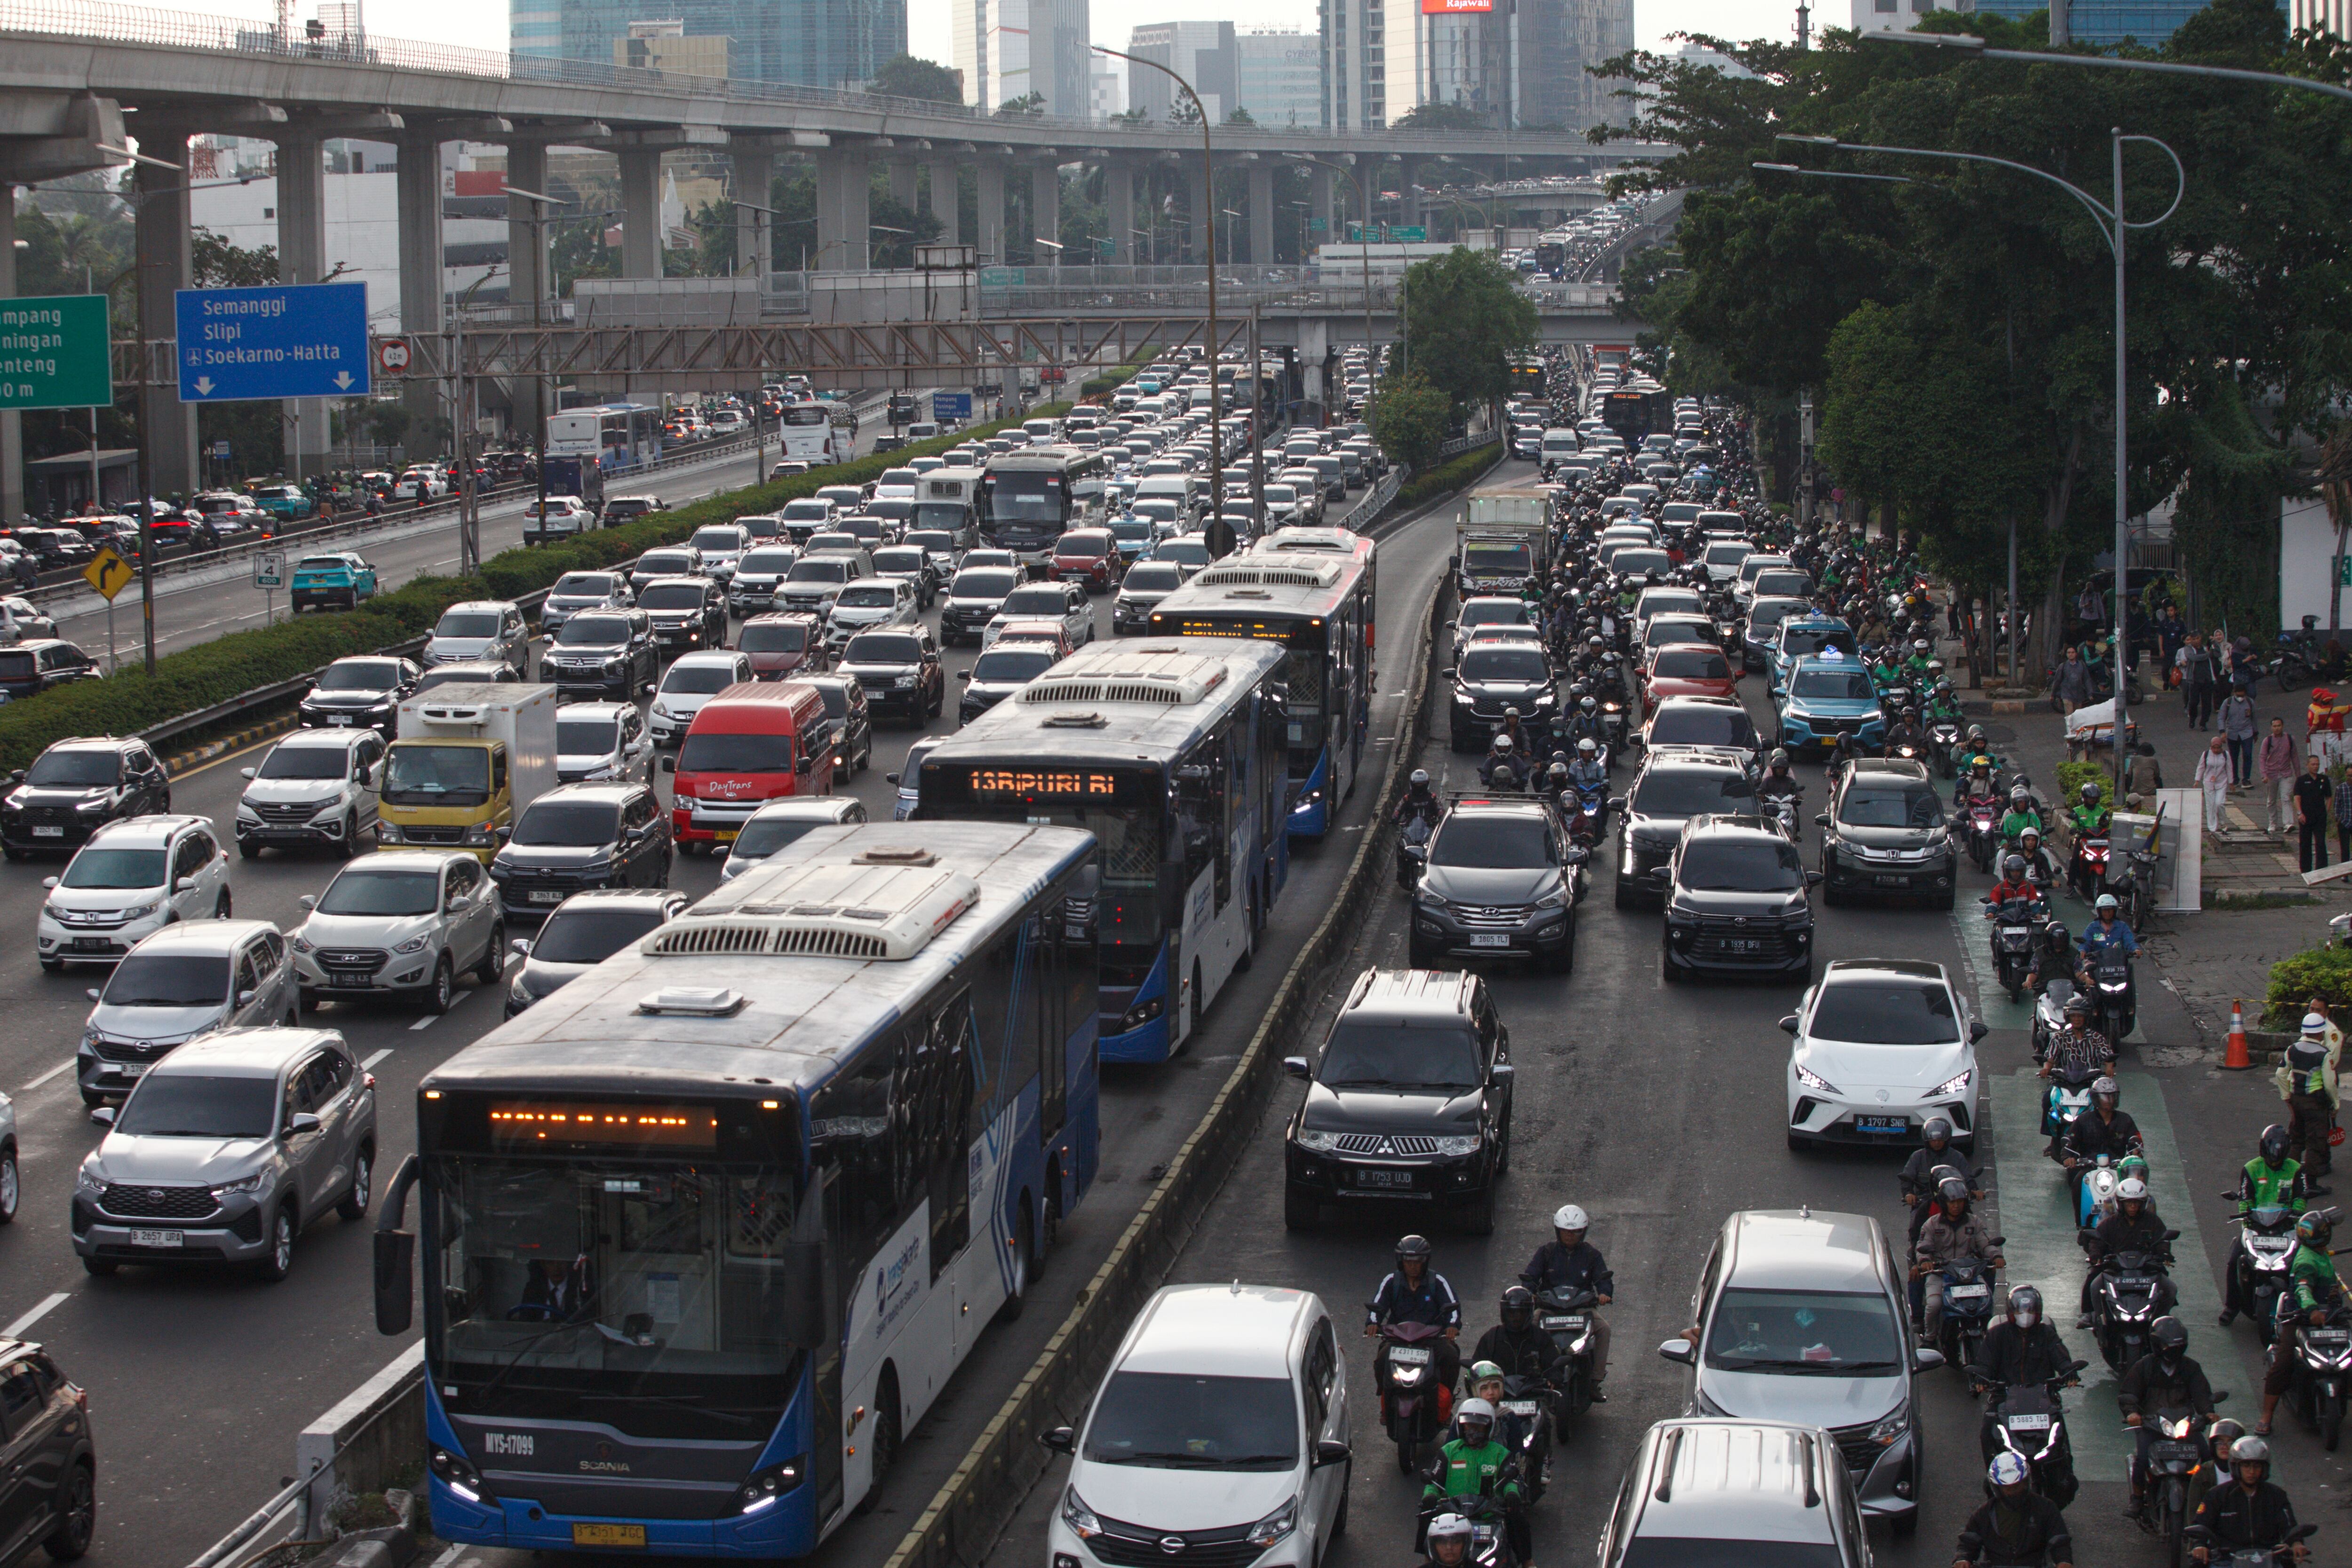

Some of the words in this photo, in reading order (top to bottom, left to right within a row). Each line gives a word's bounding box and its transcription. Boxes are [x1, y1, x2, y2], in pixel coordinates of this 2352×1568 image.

[1446, 0, 1489, 8] Rajawali
[204, 296, 286, 317] Semanggi
[0, 309, 61, 328] mpang
[204, 323, 241, 343] Slipi
[2, 333, 62, 352] ningan
[206, 345, 340, 364] Soekarno-Hatta
[19, 384, 34, 397] m
[264, 565, 274, 576] 4
[710, 780, 752, 793] DayTrans
[333, 973, 337, 982] B
[1867, 1118, 1886, 1126] 1797
[1890, 1118, 1905, 1127] SNR
[1360, 1172, 1365, 1180] B
[1375, 1172, 1391, 1182] 1753
[1396, 1173, 1411, 1183] UJD
[133, 1229, 138, 1240] B
[142, 1230, 163, 1241] 2657
[167, 1232, 182, 1242] URA
[485, 1433, 533, 1456] MYS-17099
[580, 1460, 630, 1472] SCANIA
[1482, 1464, 1497, 1474] goj
